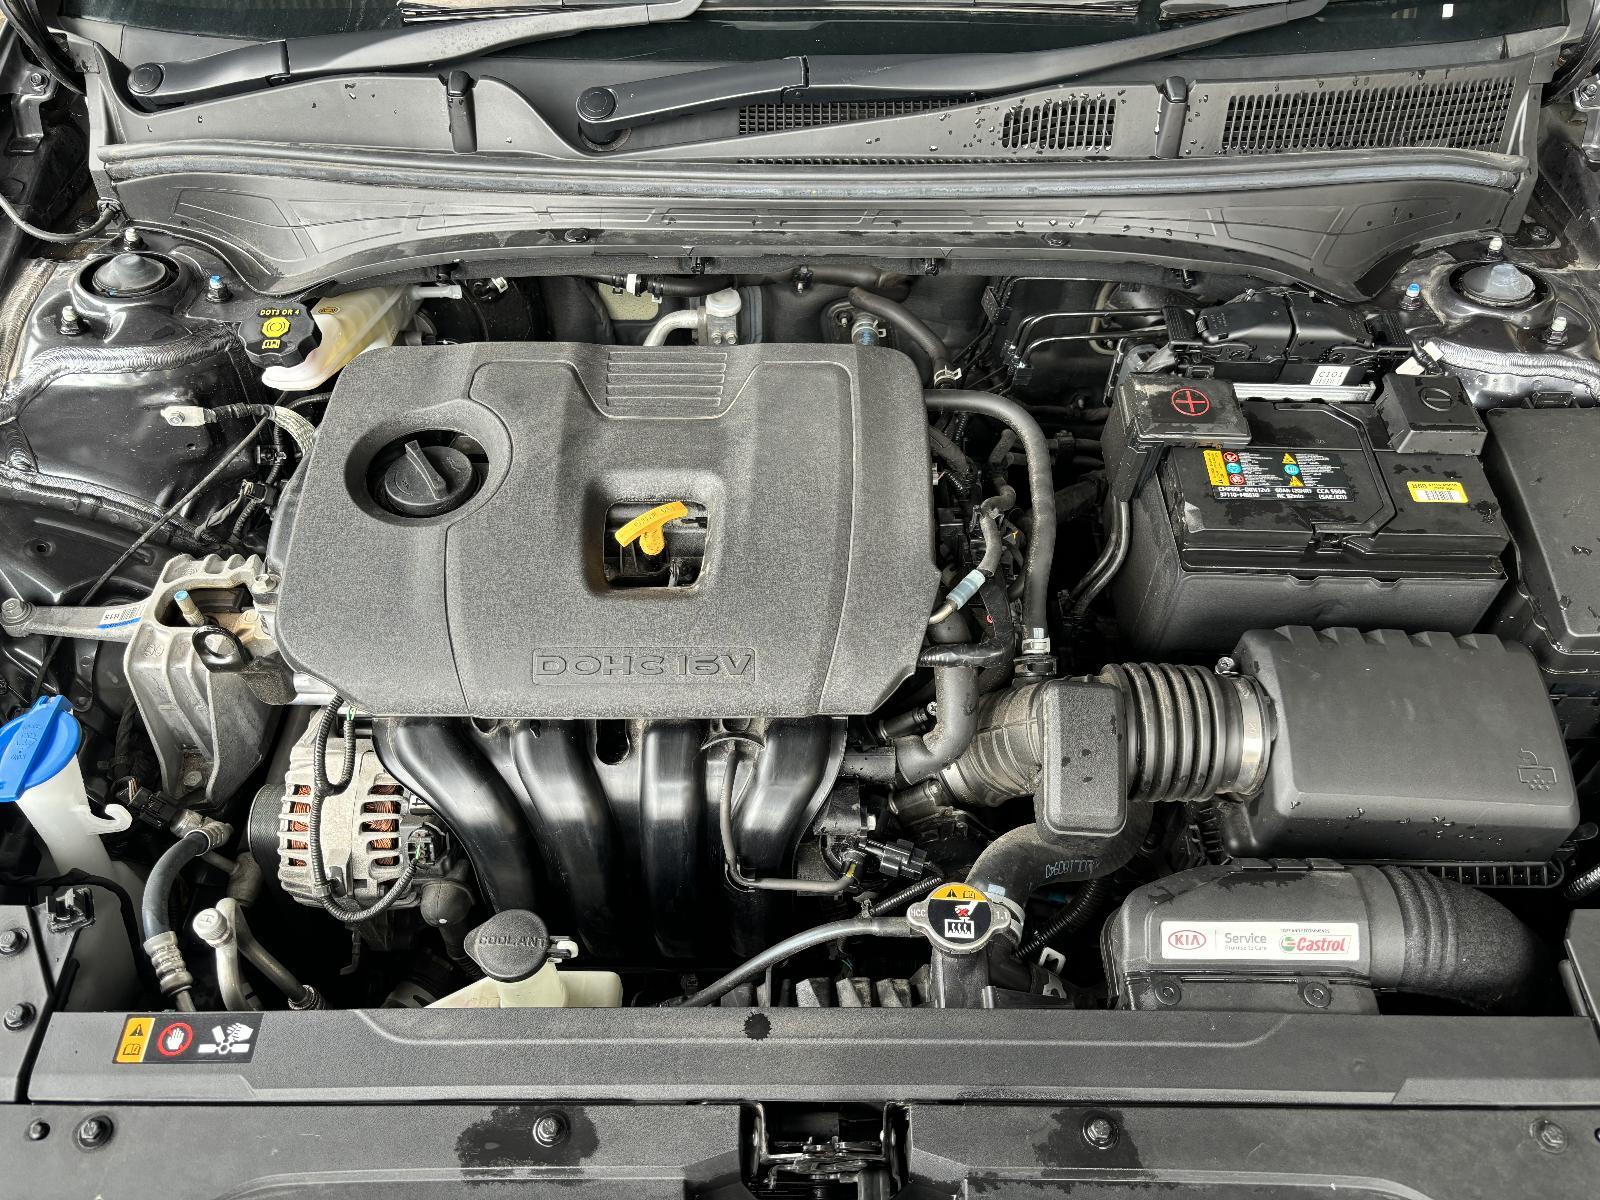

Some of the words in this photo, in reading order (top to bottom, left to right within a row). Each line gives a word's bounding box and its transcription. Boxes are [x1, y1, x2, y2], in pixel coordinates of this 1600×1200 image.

[535, 655, 665, 676] DOHC
[676, 654, 751, 676] 16V
[479, 936, 545, 948] COOLANT
[1174, 934, 1201, 946] KIA
[1224, 932, 1267, 944] Service
[1296, 937, 1346, 952] Castrol
